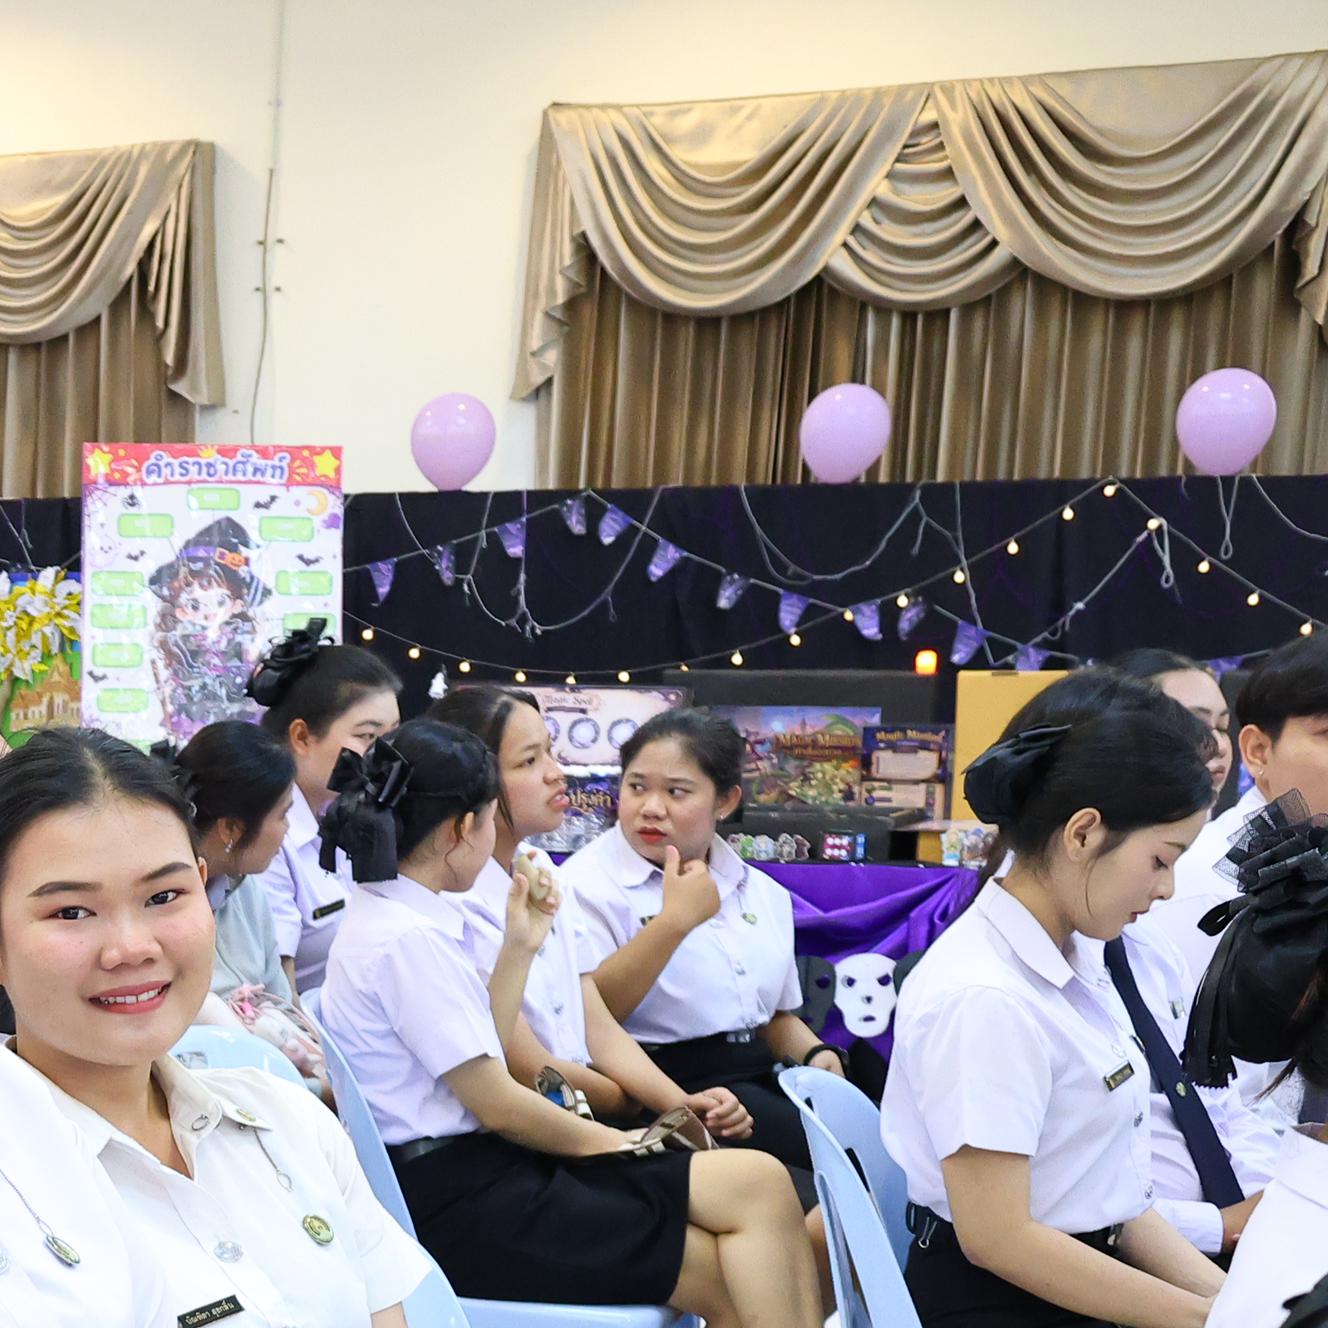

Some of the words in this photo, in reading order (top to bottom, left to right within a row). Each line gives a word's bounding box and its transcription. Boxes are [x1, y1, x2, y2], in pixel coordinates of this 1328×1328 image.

[145, 453, 287, 480] คำราชาศัพท์
